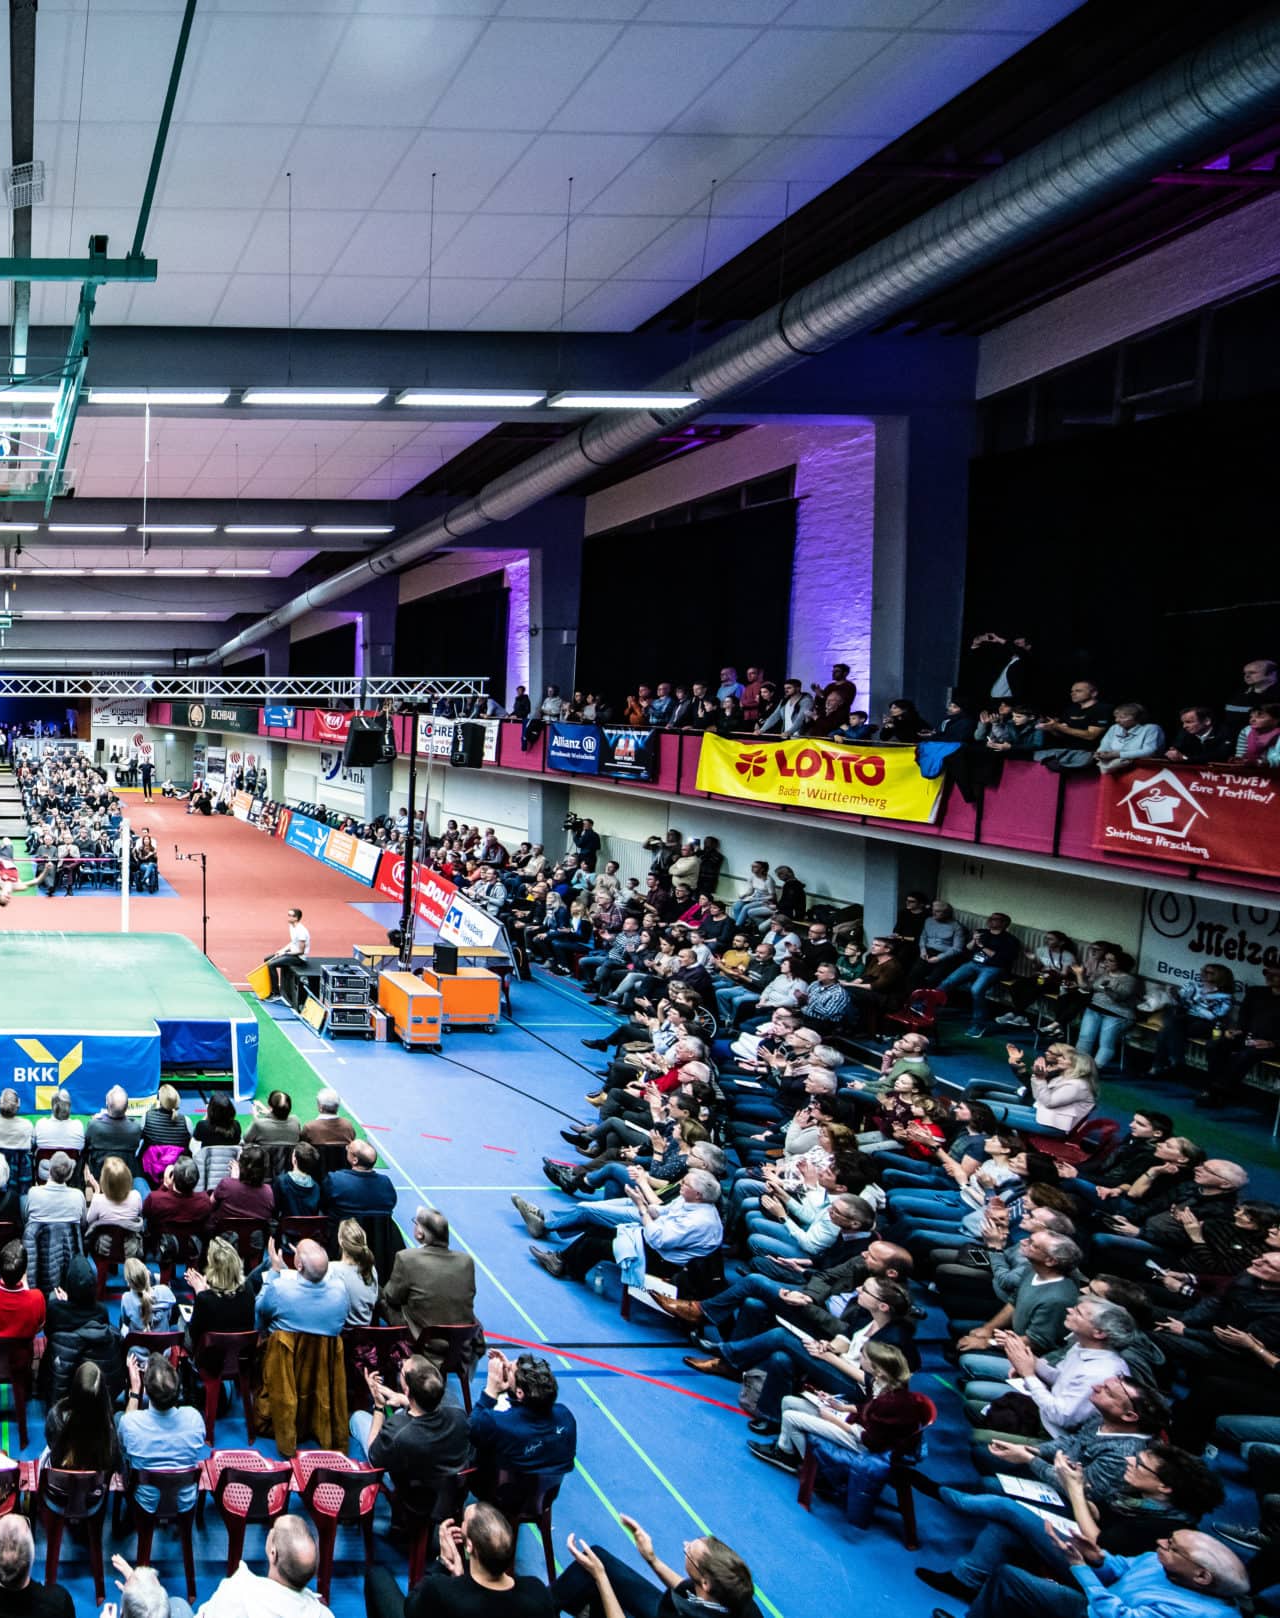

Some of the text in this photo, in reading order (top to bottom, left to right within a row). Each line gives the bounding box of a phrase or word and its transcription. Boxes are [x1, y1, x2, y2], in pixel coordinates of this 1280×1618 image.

[420, 723, 454, 738] LOHRE
[552, 735, 581, 750] Allianz
[775, 748, 885, 787] LOTTO
[1189, 781, 1214, 794] Eure
[1199, 771, 1271, 789] Wir TUNEN
[778, 784, 888, 810] Baden-Württemberg
[1105, 826, 1210, 859] Shirthaus Hirschberg
[1157, 960, 1202, 983] Bresla
[245, 1034, 257, 1044] Die
[14, 1067, 54, 1083] BKK
